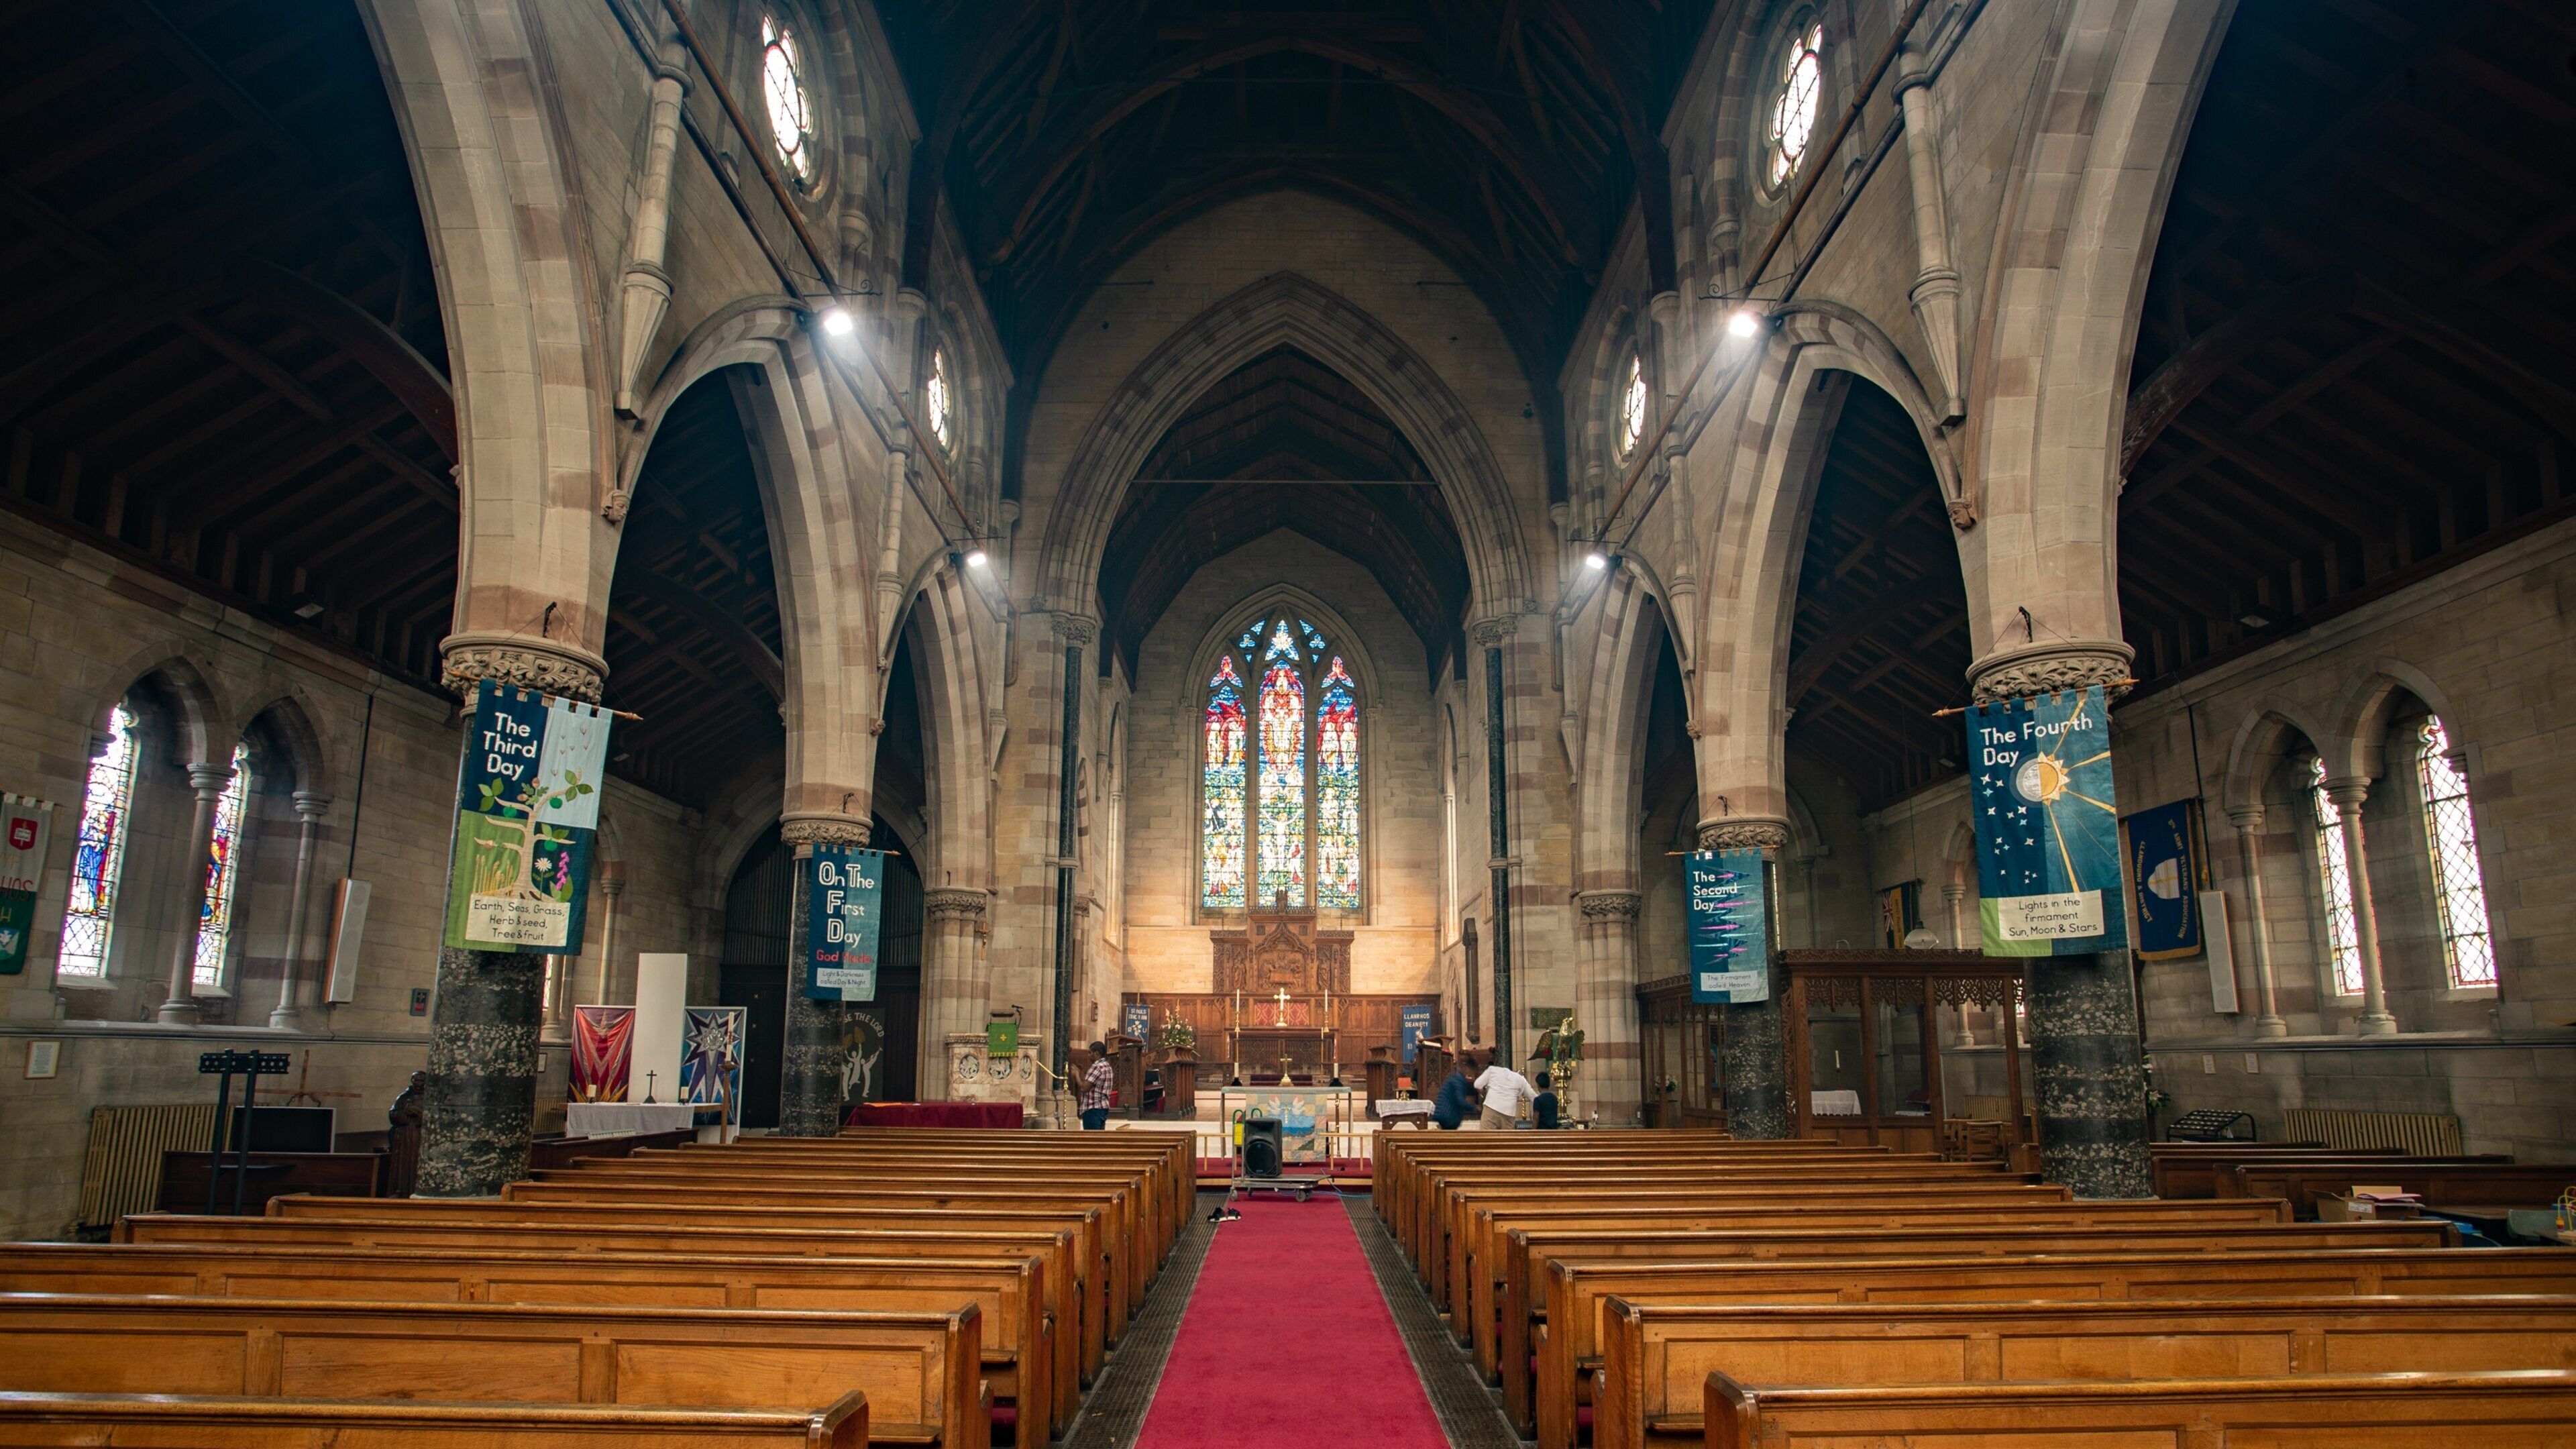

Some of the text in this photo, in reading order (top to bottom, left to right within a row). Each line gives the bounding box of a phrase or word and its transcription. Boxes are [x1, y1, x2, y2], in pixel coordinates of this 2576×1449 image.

[495, 712, 531, 737] The
[1980, 712, 2093, 745] The Fourth
[484, 731, 537, 758] Third
[1983, 747, 2019, 767] Day
[487, 753, 524, 781] Day
[818, 861, 875, 889] On The
[1693, 871, 1716, 883] The
[1693, 882, 1737, 897] Second
[474, 900, 566, 917] Earth, Seas, Grass,
[826, 890, 865, 916] First
[1693, 899, 1715, 912] Day
[2018, 897, 2081, 913] Lights in the
[489, 914, 548, 929] Herb & seed,
[2025, 912, 2079, 922] firmament
[2177, 895, 2188, 939] ASSOCIATION
[492, 928, 545, 941] Tree & fruit
[826, 918, 861, 948] Day
[2031, 926, 2057, 936] Moon
[2058, 923, 2066, 933] &
[2069, 922, 2098, 933] Stars
[816, 949, 839, 962] God
[822, 970, 836, 978] Light
[852, 979, 866, 987] Night
[854, 1012, 871, 1023] THE
[869, 1018, 885, 1037] LORD
